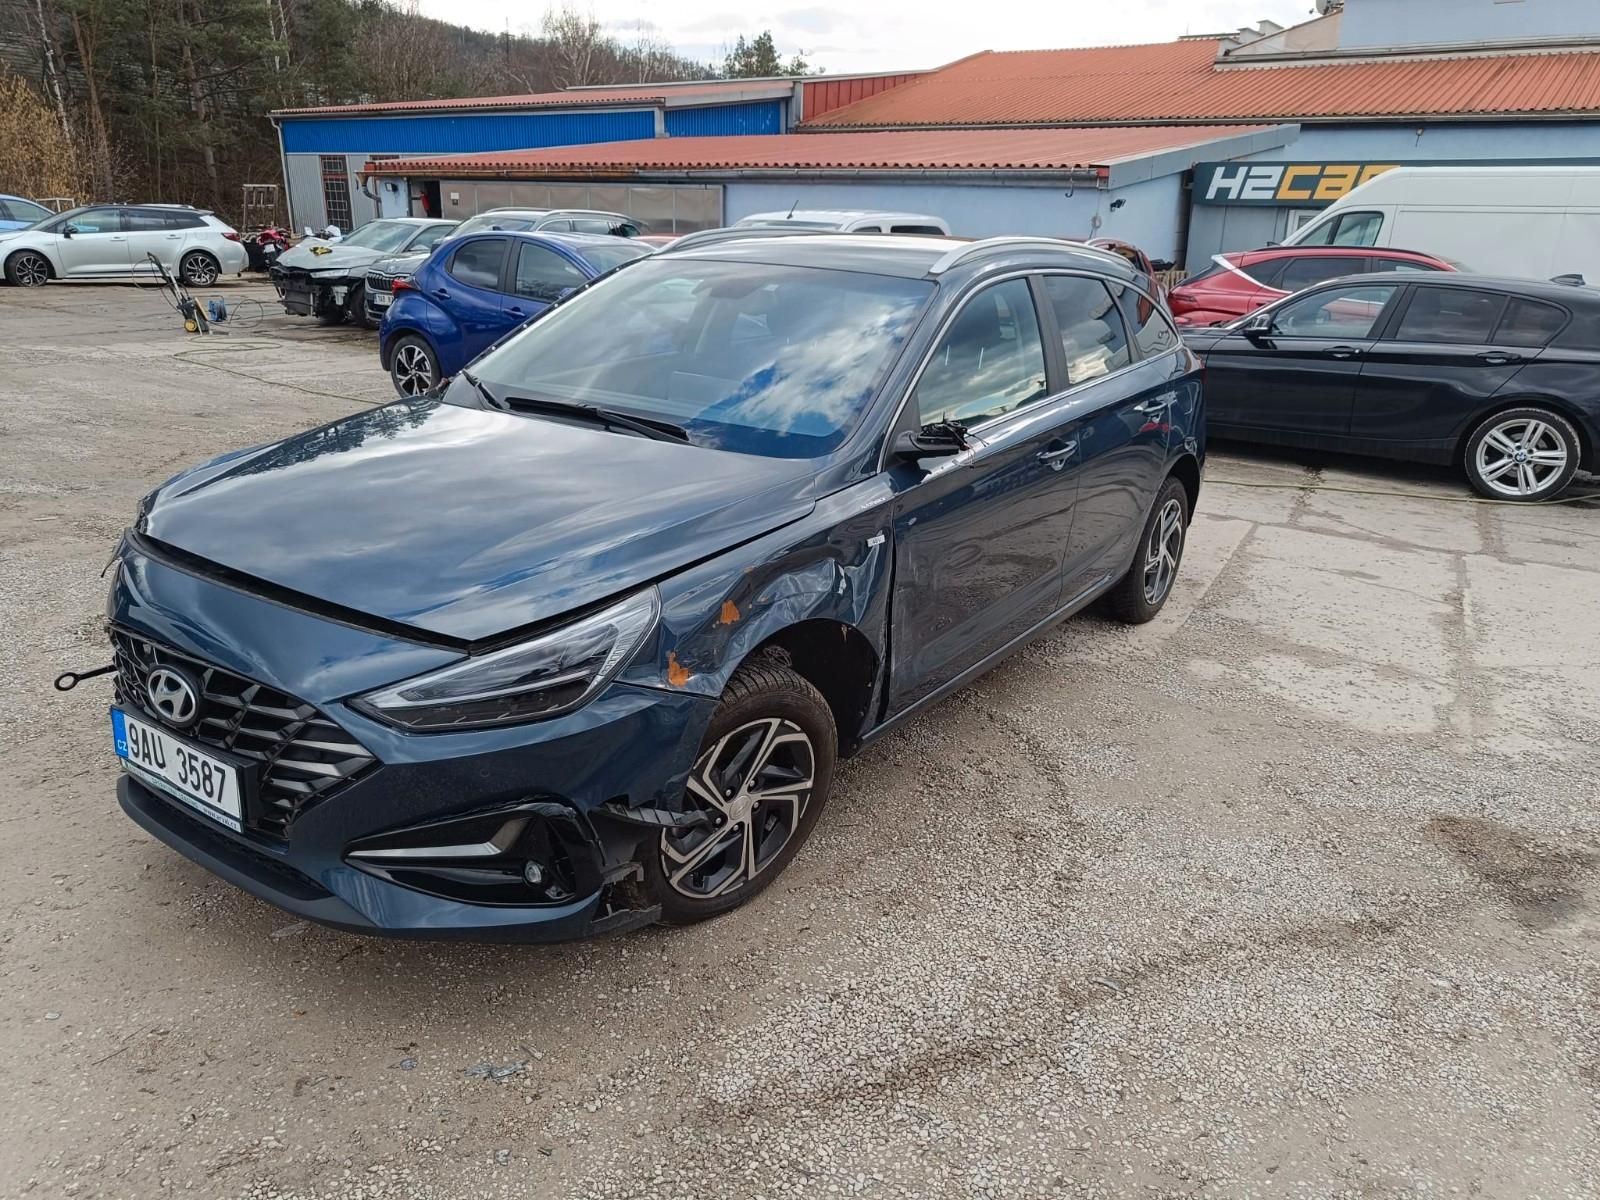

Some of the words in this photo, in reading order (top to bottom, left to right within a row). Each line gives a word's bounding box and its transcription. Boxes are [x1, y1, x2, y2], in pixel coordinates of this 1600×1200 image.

[117, 739, 128, 752] CZ
[128, 722, 166, 770] 9AU
[176, 747, 226, 804] 3587
